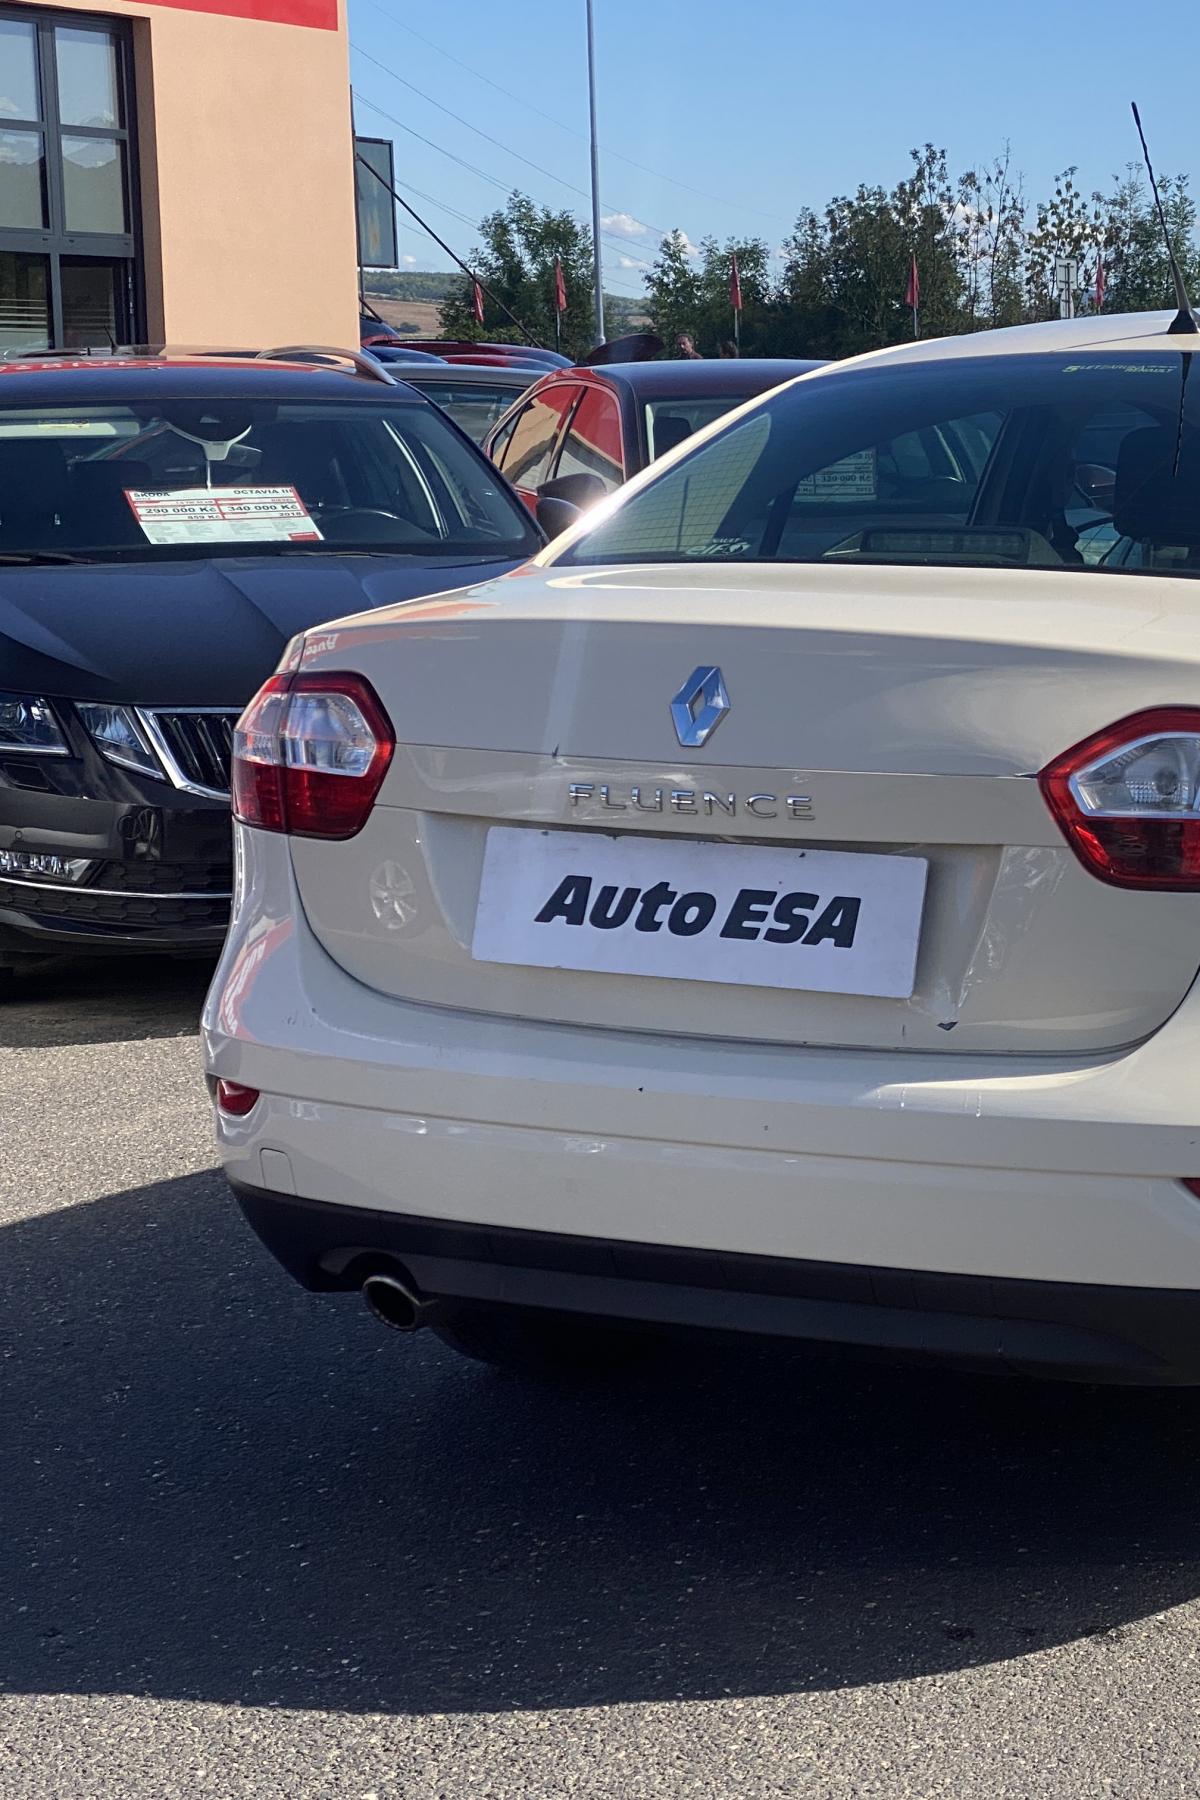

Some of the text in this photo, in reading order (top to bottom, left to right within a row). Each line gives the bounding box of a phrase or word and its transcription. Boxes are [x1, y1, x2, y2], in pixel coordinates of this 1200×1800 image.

[568, 782, 816, 821] FLUENCE
[534, 874, 862, 949] Auto ESA
